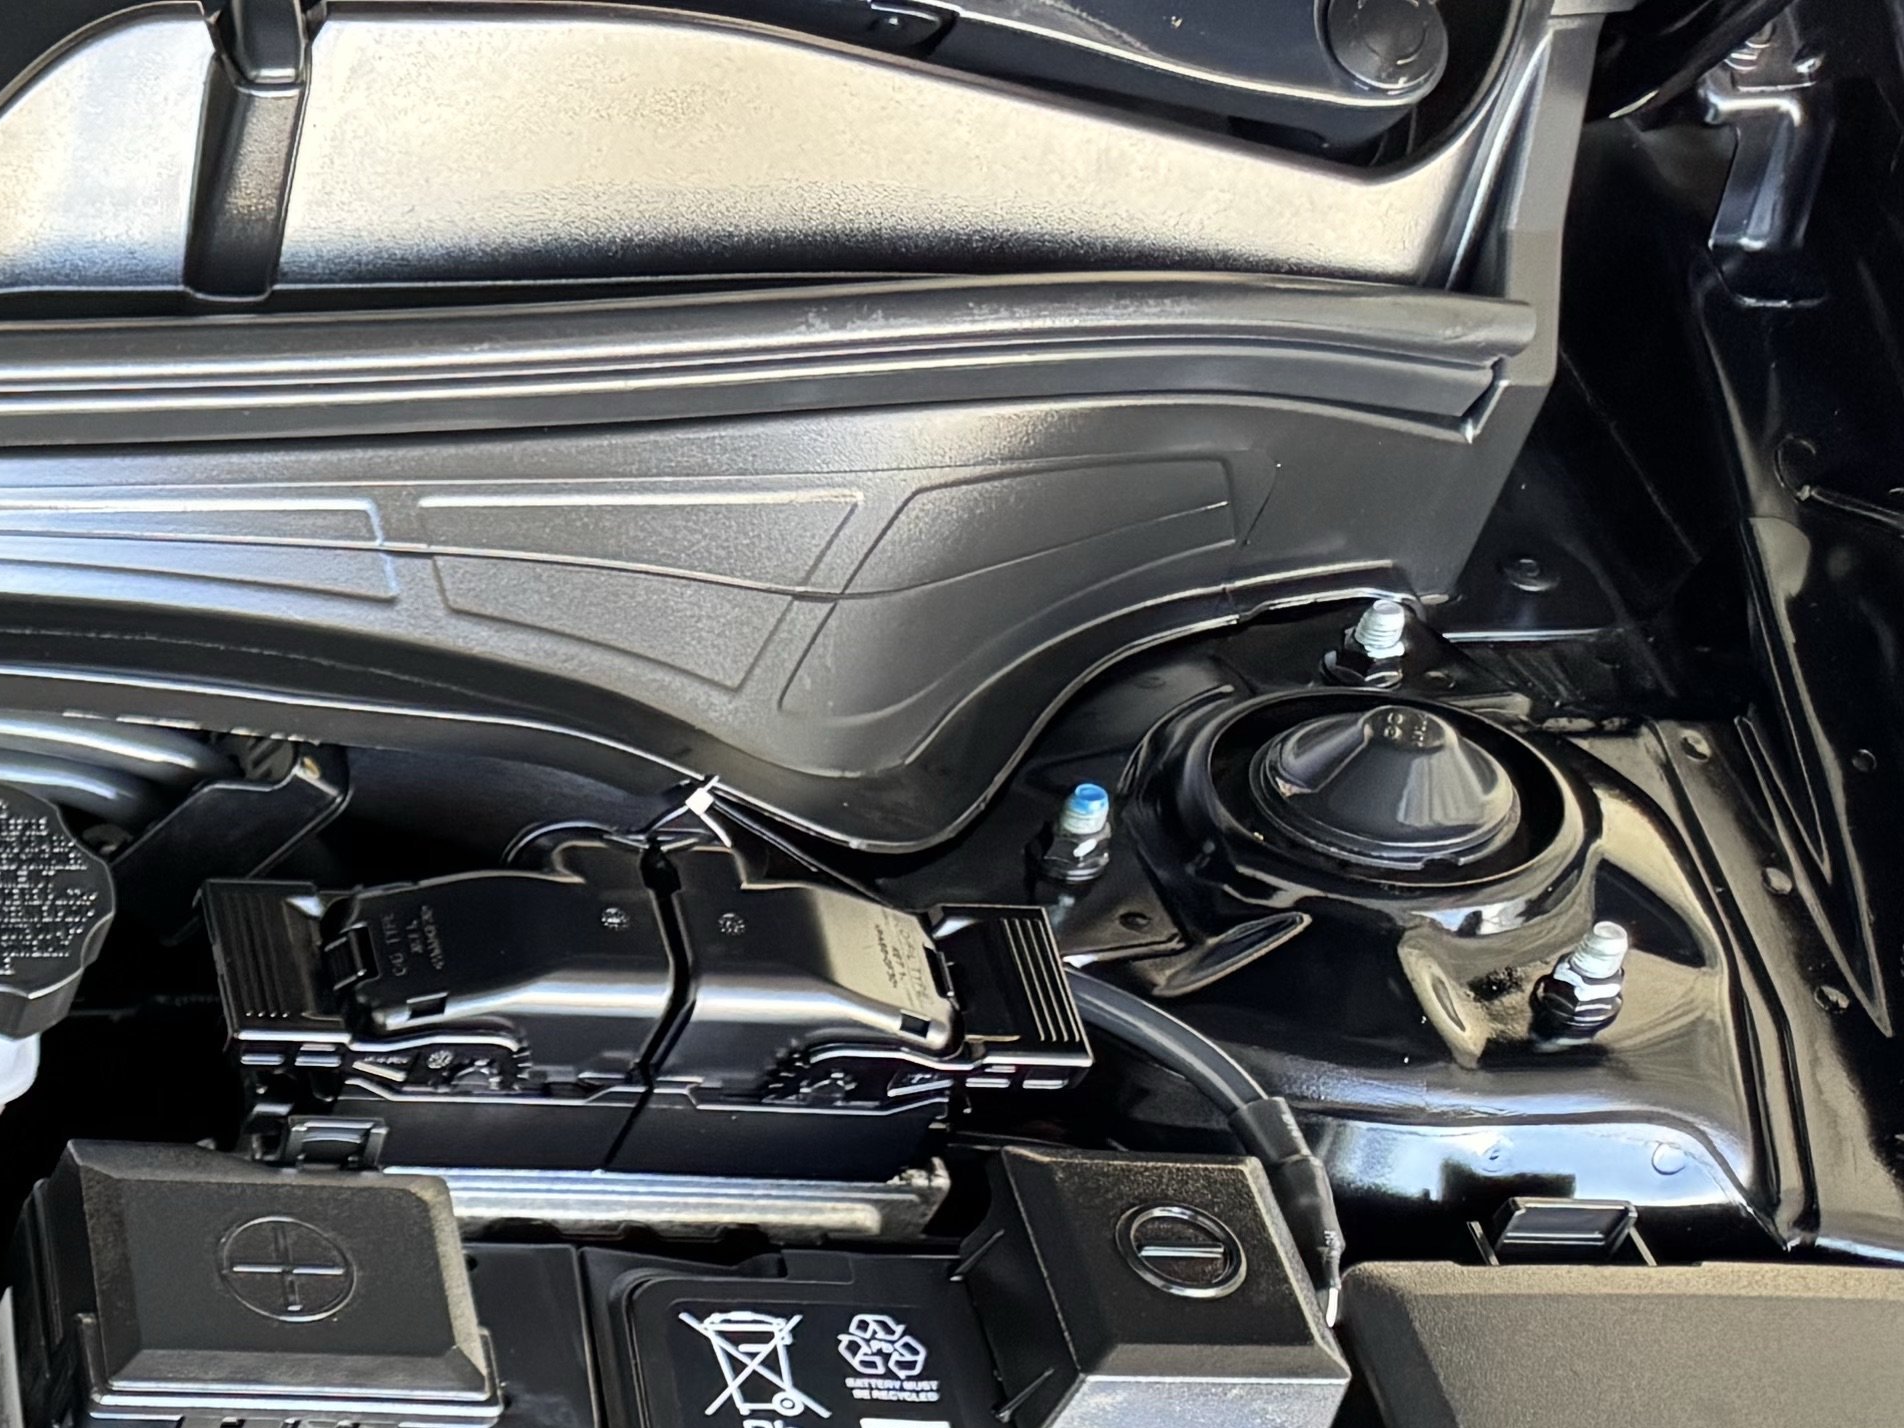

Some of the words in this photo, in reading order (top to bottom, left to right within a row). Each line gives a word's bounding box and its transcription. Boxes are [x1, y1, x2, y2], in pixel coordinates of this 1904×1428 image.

[845, 1378, 901, 1390] BATTERY
[903, 1380, 940, 1391] MUST
[872, 1389, 941, 1402] RECYCLED
